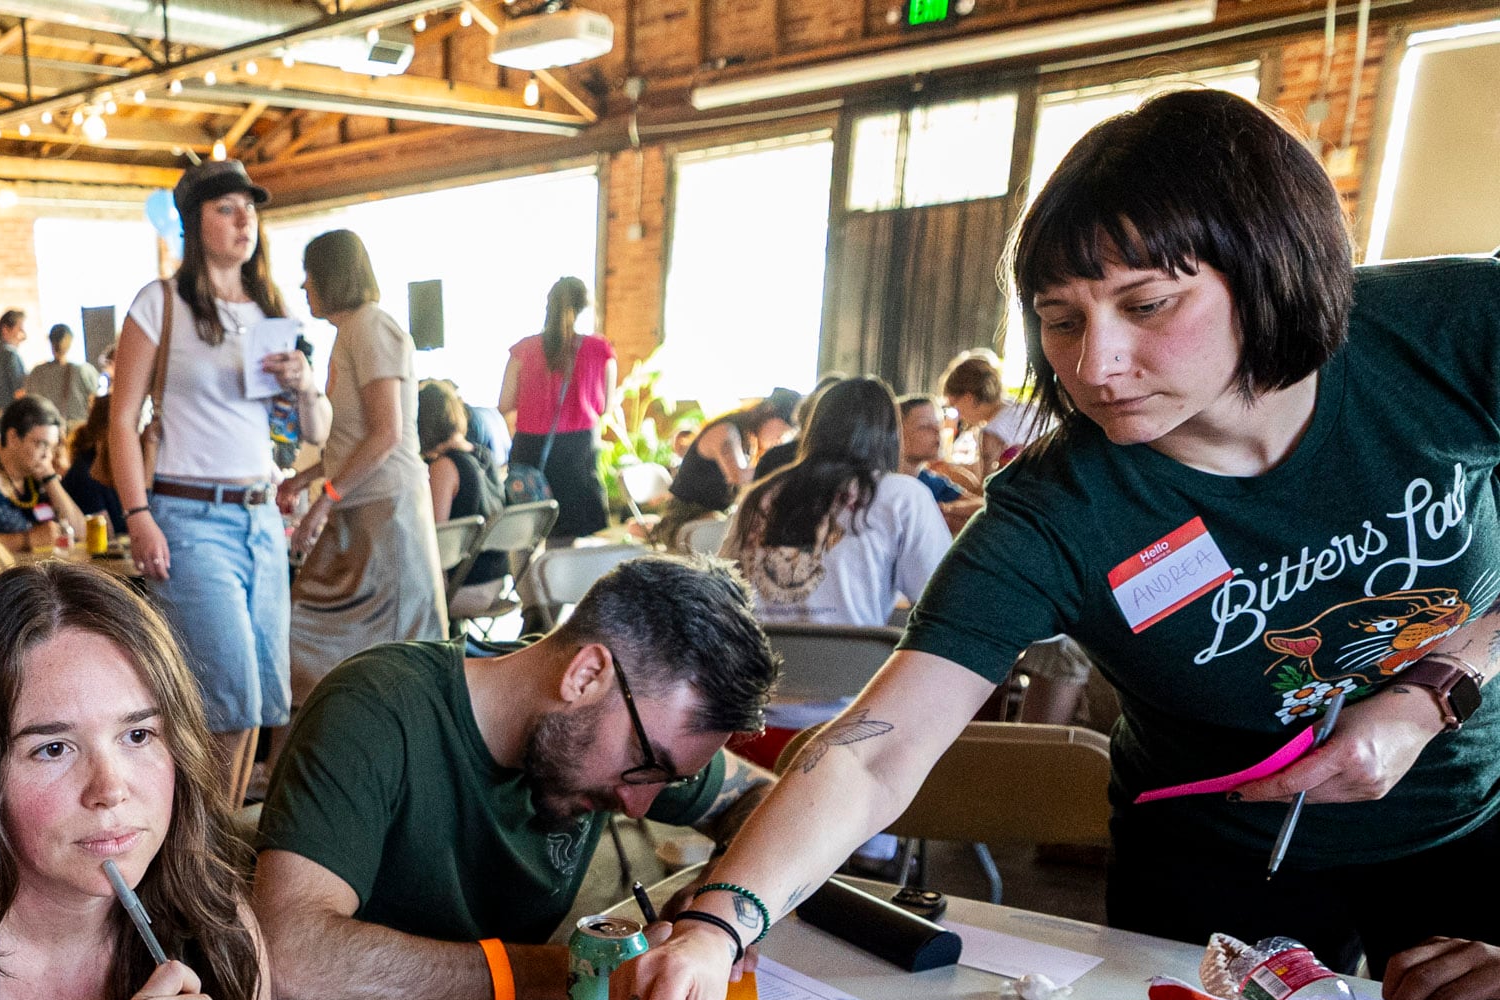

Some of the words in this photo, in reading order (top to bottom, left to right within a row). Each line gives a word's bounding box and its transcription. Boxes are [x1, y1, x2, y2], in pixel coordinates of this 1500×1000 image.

[1132, 549, 1214, 610] ANDREA
[1139, 539, 1169, 562] Hello
[1194, 520, 1388, 665] Bitters
